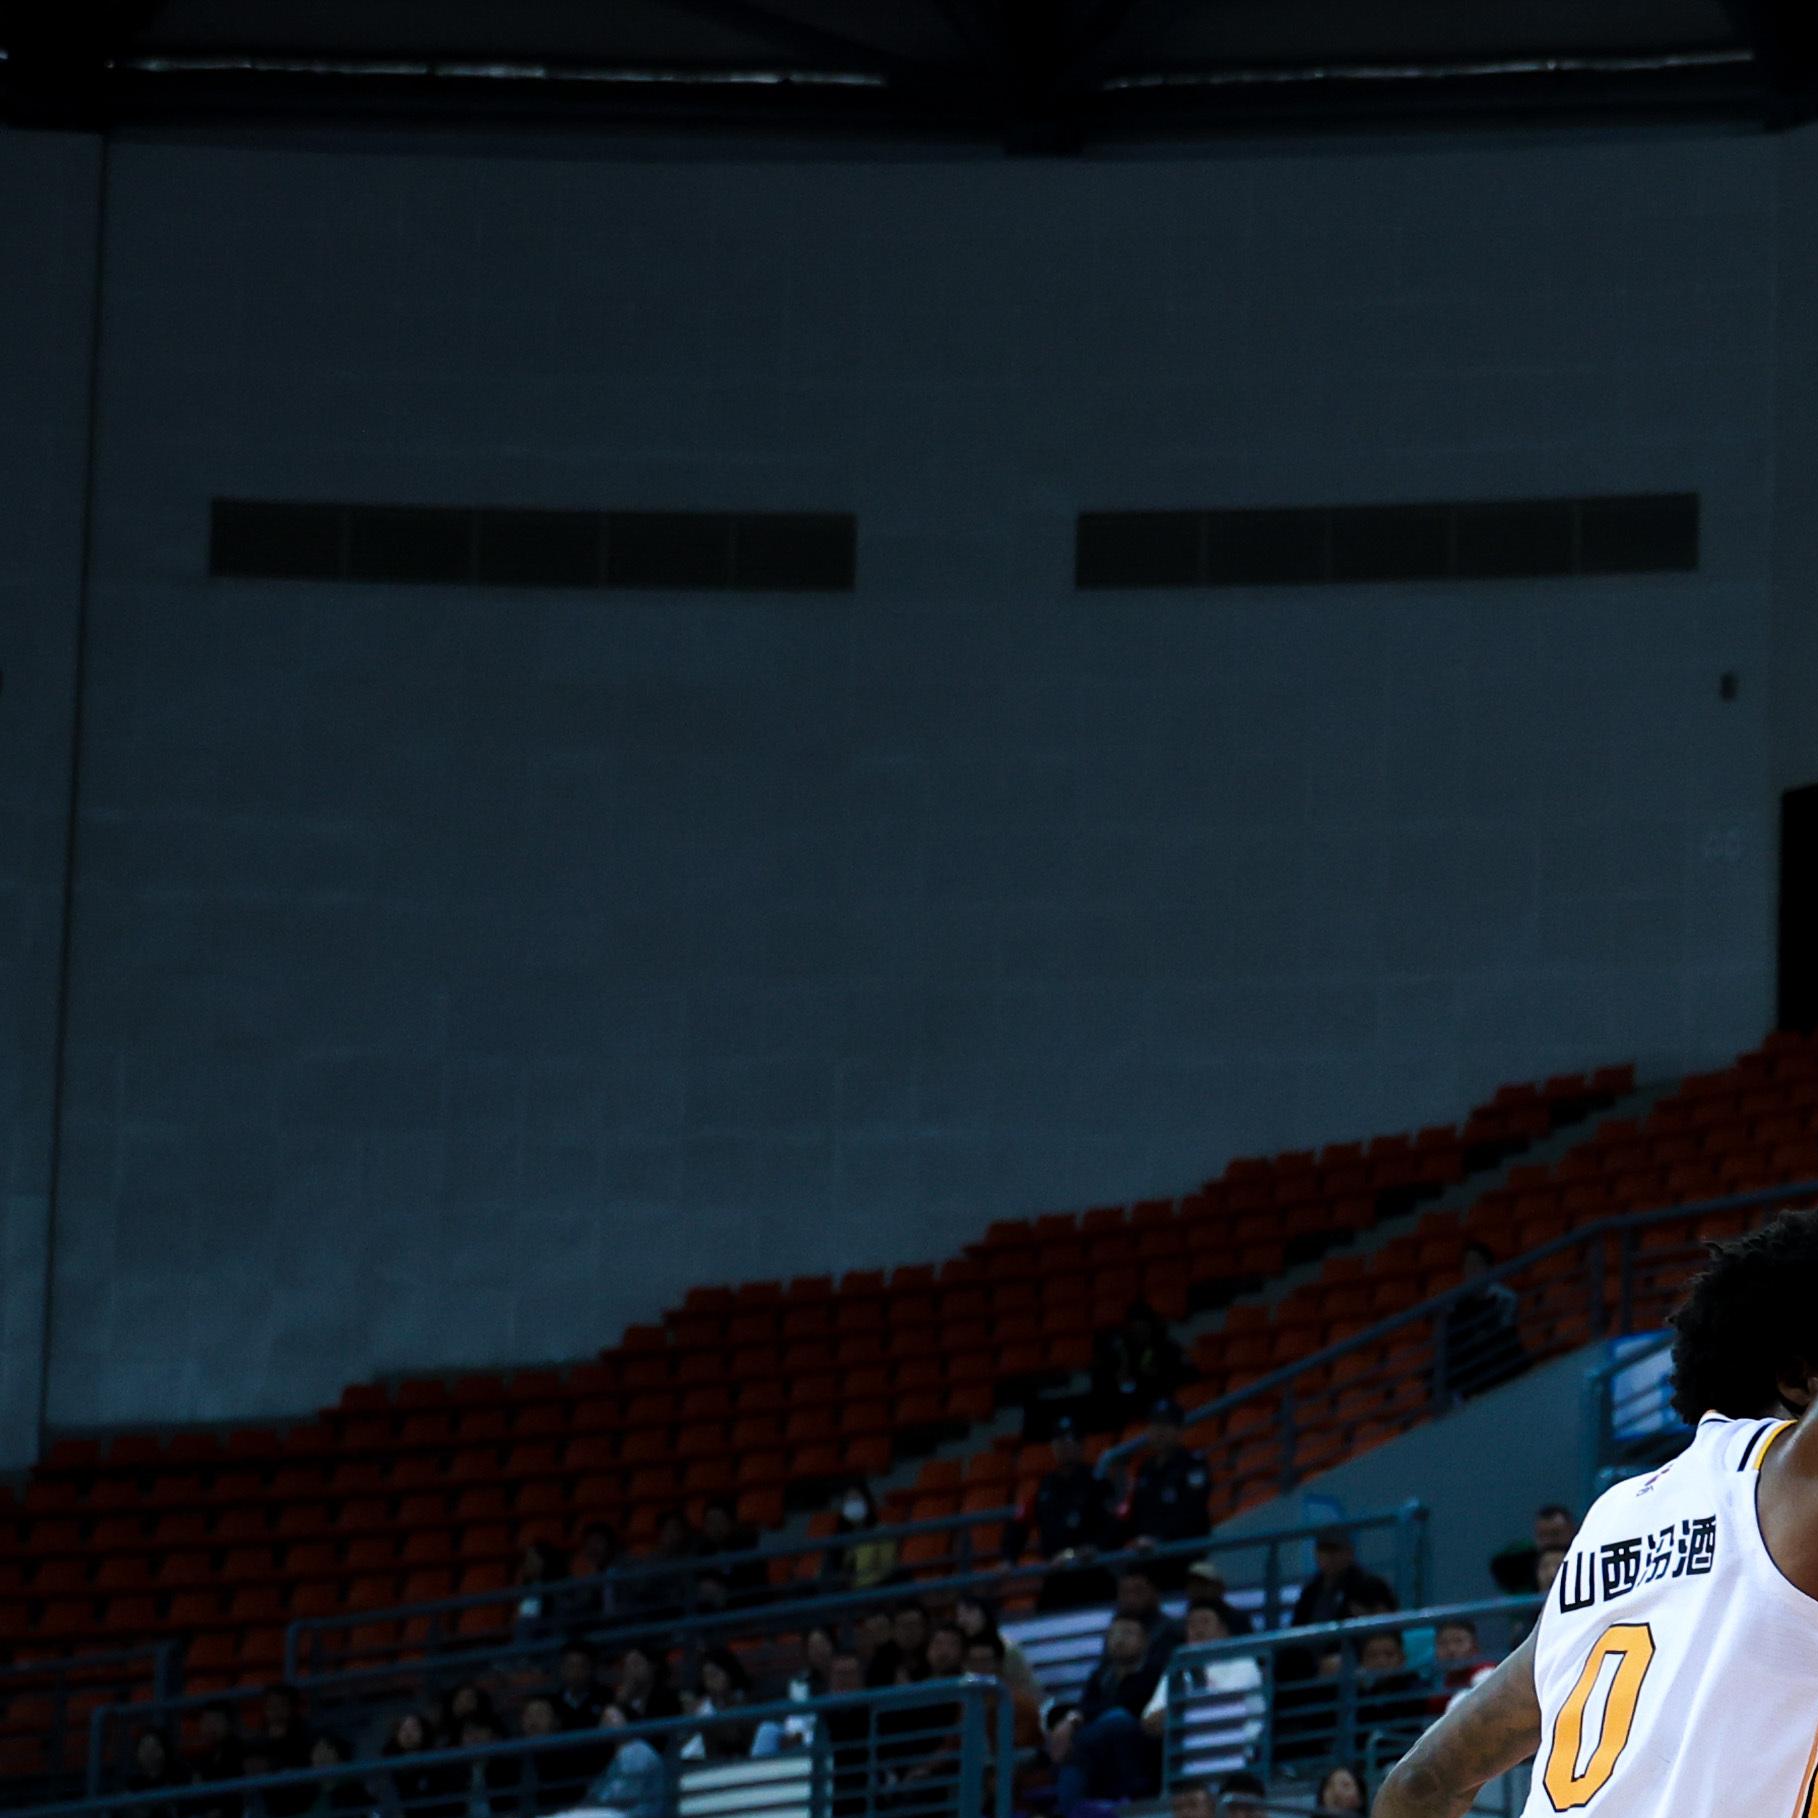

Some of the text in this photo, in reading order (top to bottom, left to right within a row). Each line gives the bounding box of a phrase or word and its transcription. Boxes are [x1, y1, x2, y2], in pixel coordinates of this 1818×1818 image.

[1559, 1513, 1717, 1614] 山西汾酒
[1542, 1622, 1656, 1813] 0
